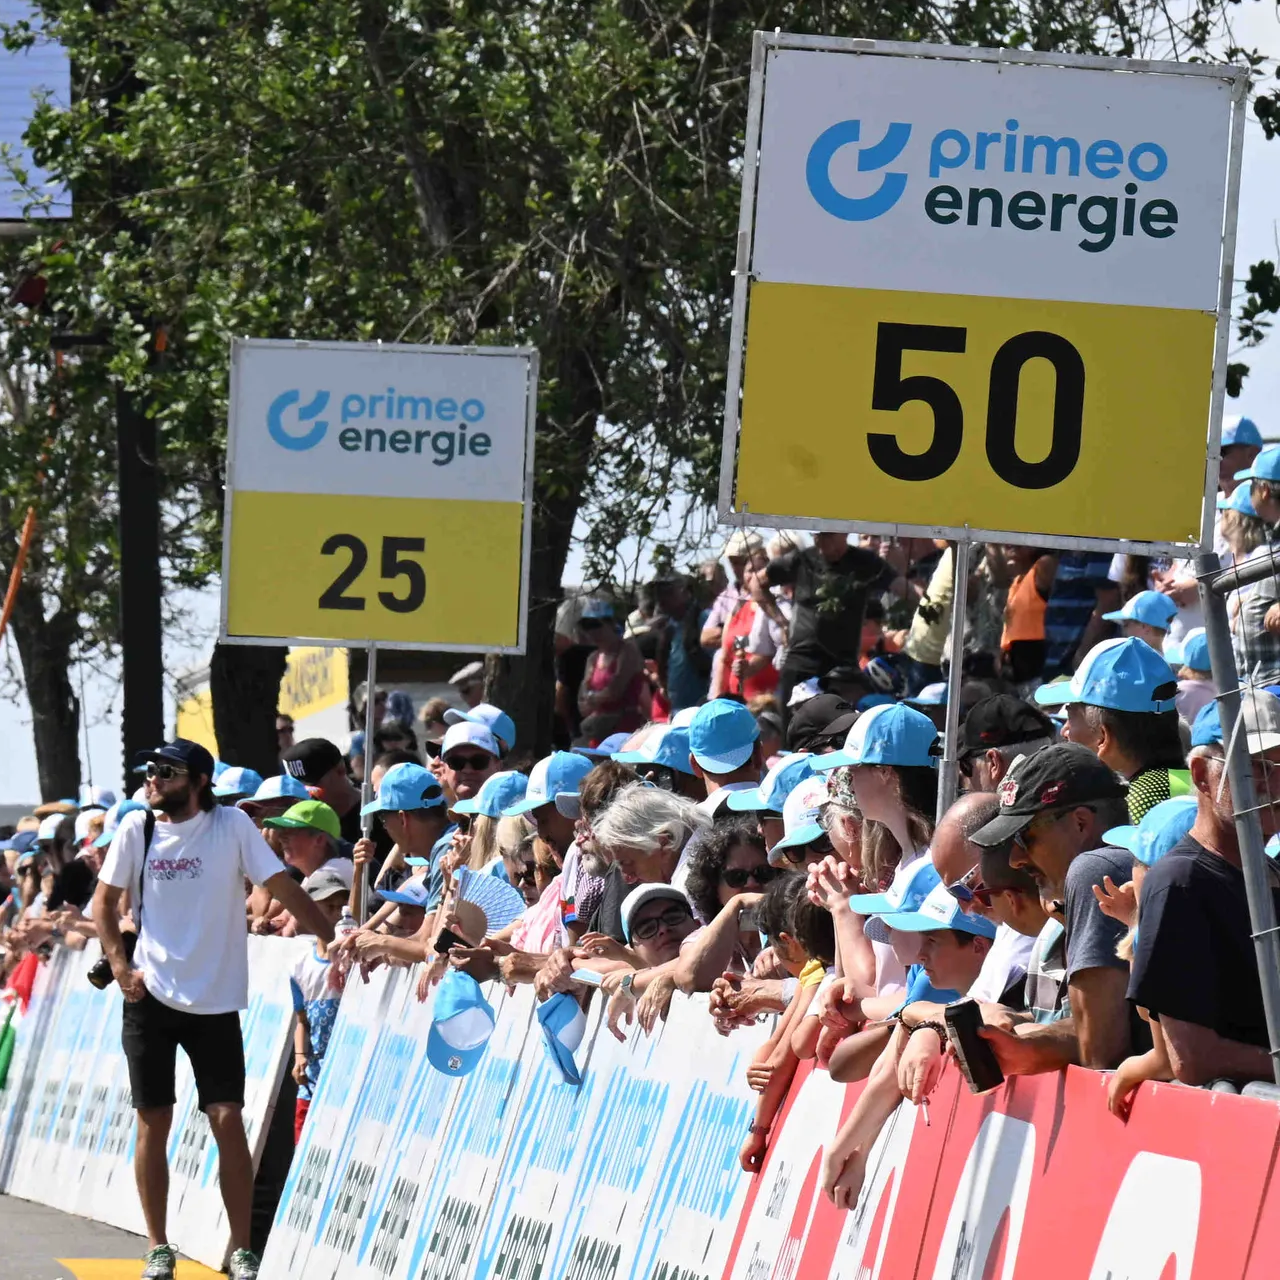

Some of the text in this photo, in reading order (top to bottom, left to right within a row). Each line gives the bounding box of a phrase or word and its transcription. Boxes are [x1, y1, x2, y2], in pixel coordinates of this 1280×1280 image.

[929, 118, 1169, 182] primeo
[924, 182, 1179, 253] energie
[341, 387, 486, 425] primeo
[866, 320, 1086, 490] 50
[338, 423, 492, 466] energie
[317, 532, 427, 614] 25
